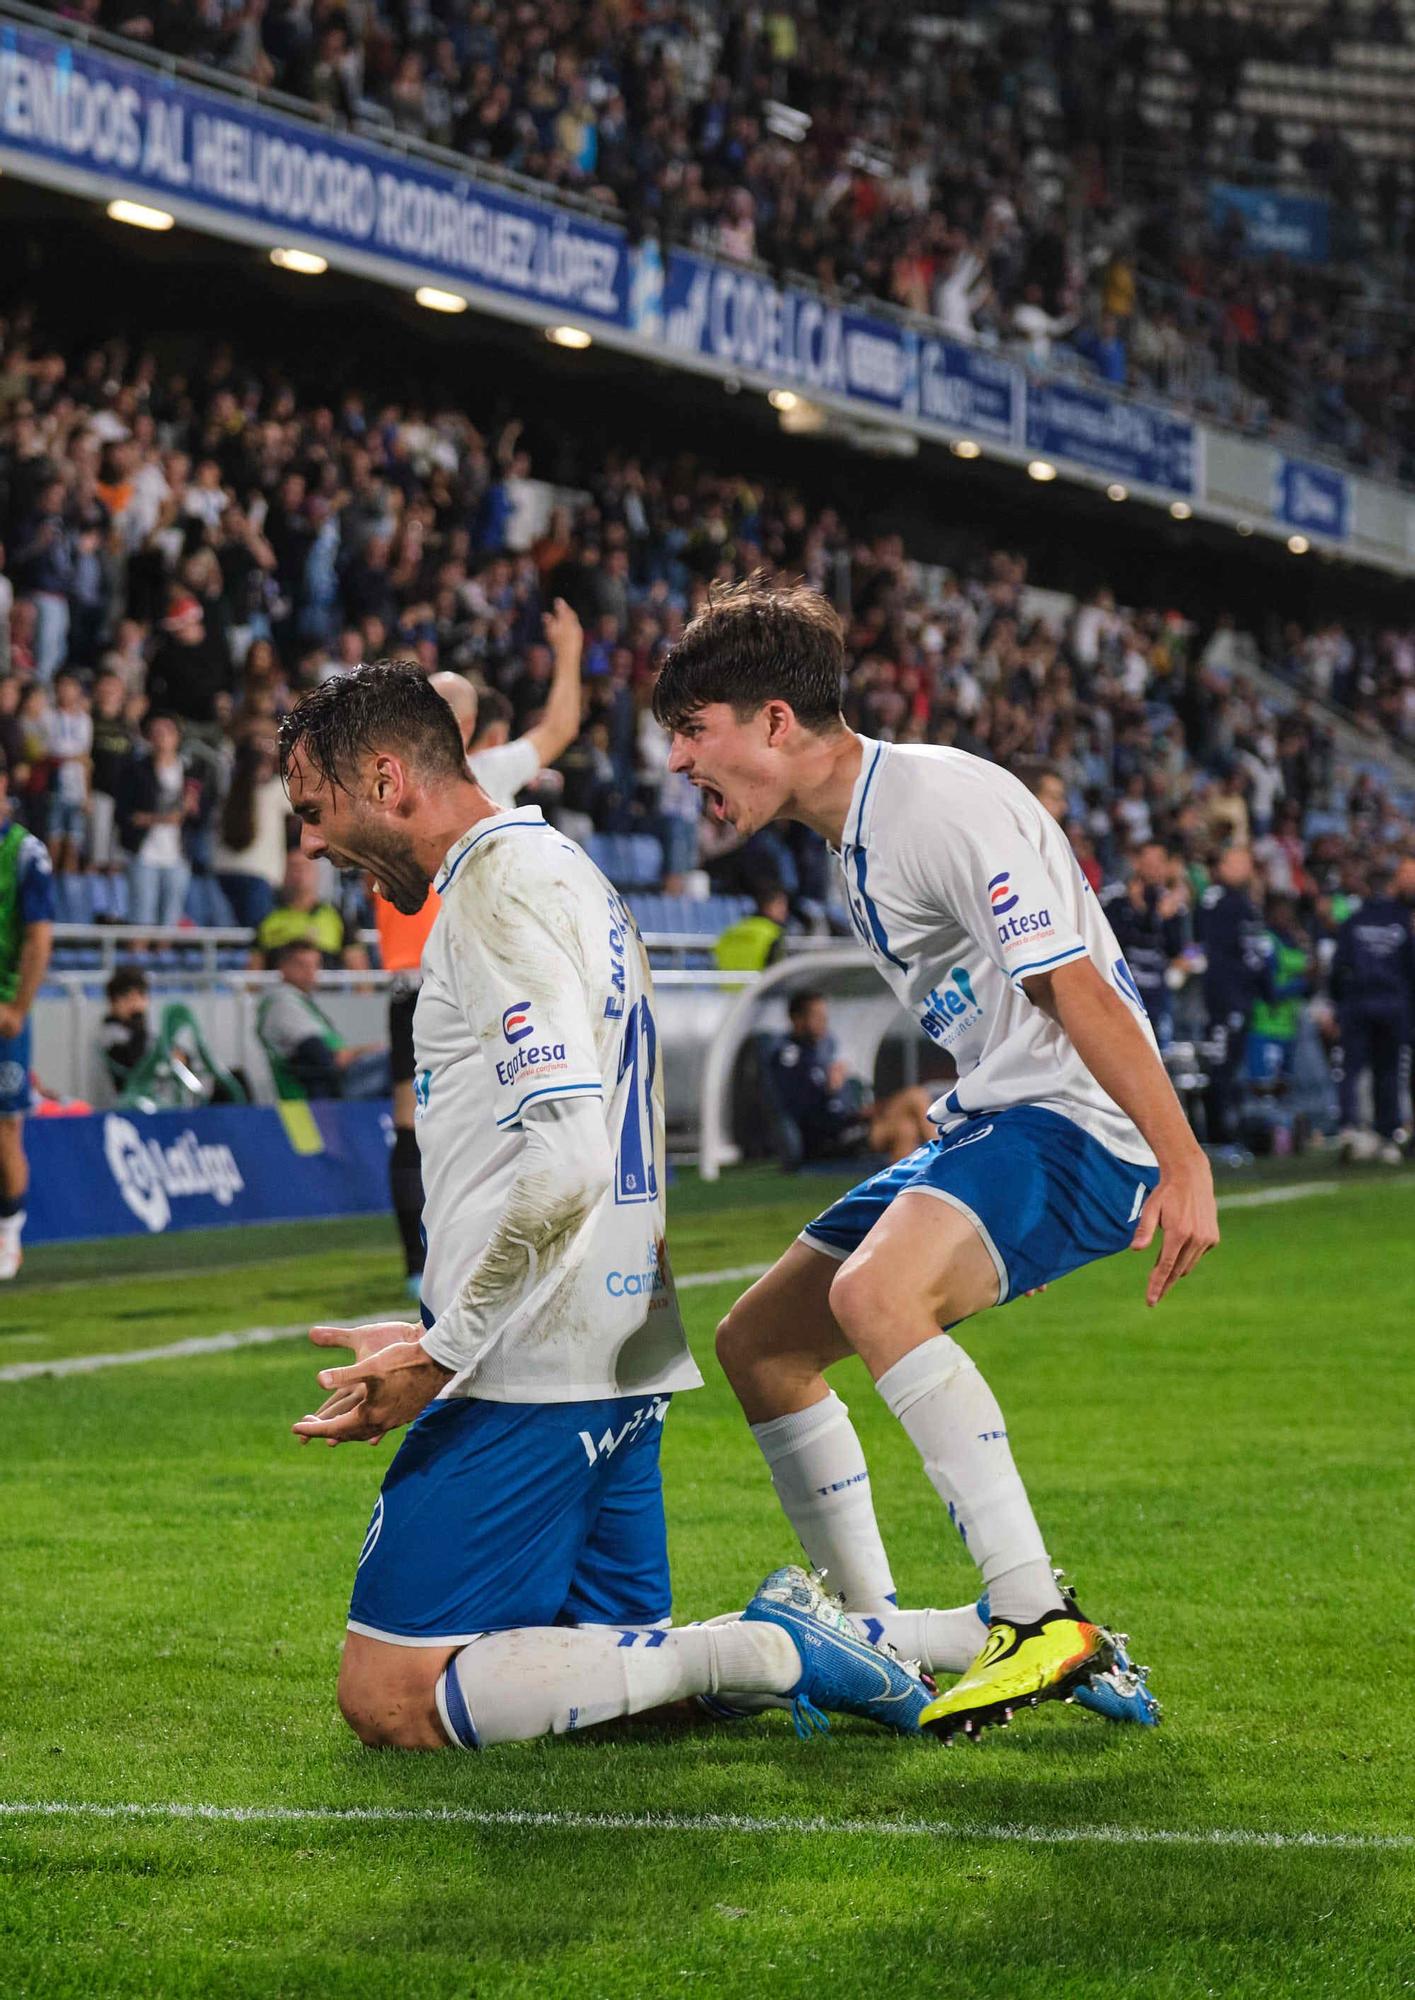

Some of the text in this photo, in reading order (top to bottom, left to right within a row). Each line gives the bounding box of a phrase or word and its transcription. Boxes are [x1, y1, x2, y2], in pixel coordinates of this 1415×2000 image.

[0, 50, 141, 166] ENIDOS
[142, 98, 192, 184] AL
[193, 112, 375, 240] HELIODORO
[998, 909, 1051, 945] atesa
[496, 1044, 566, 1086] Egatesa
